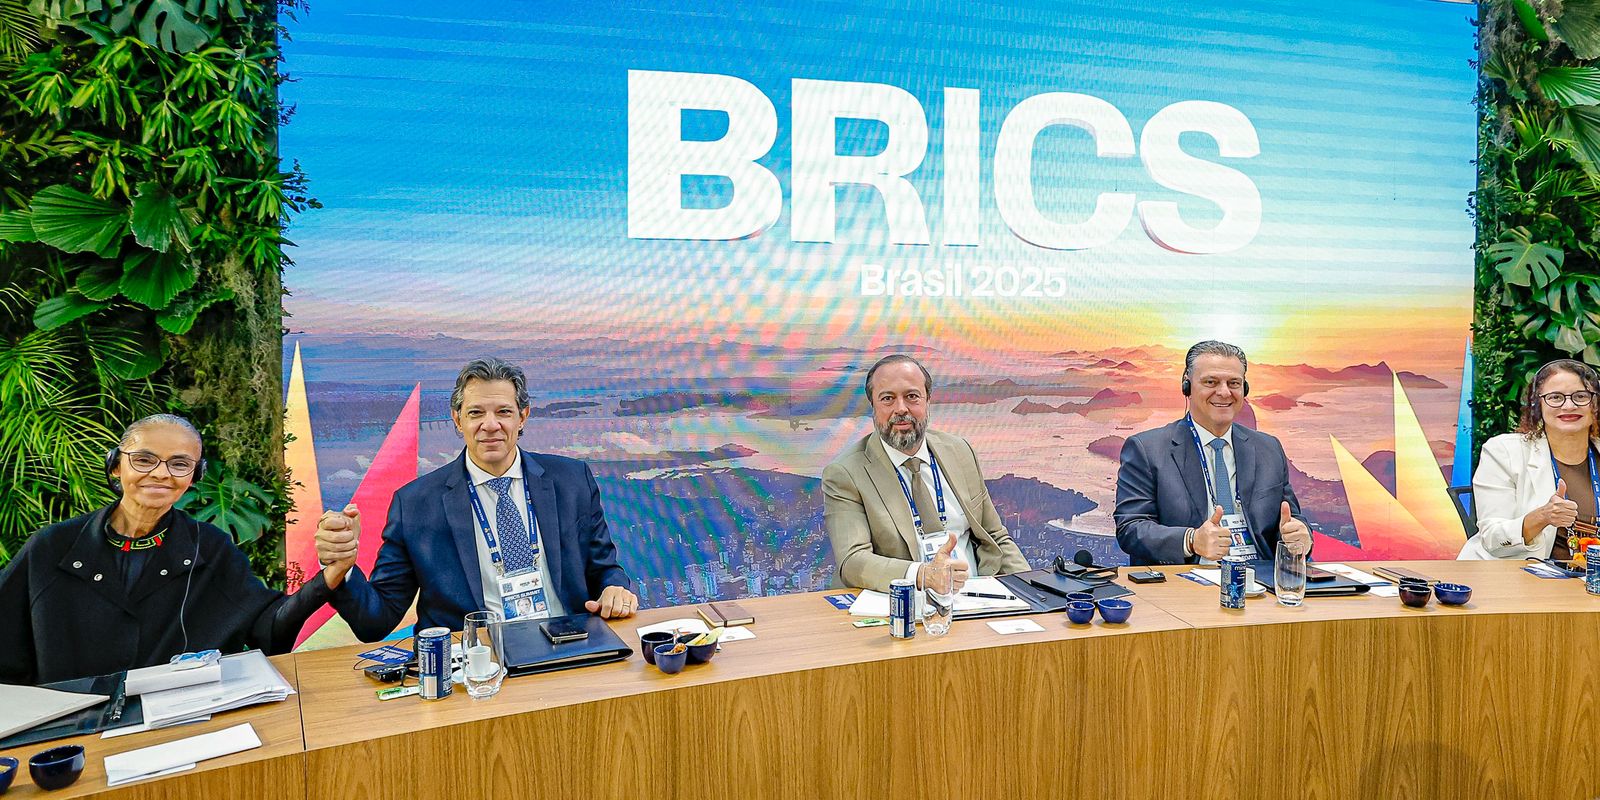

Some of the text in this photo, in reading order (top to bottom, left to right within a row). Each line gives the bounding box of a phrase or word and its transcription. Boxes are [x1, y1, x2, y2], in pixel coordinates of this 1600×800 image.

[627, 69, 1262, 254] BRICS
[861, 263, 1067, 298] Brasil 2025
[520, 589, 541, 599] SUMMIT
